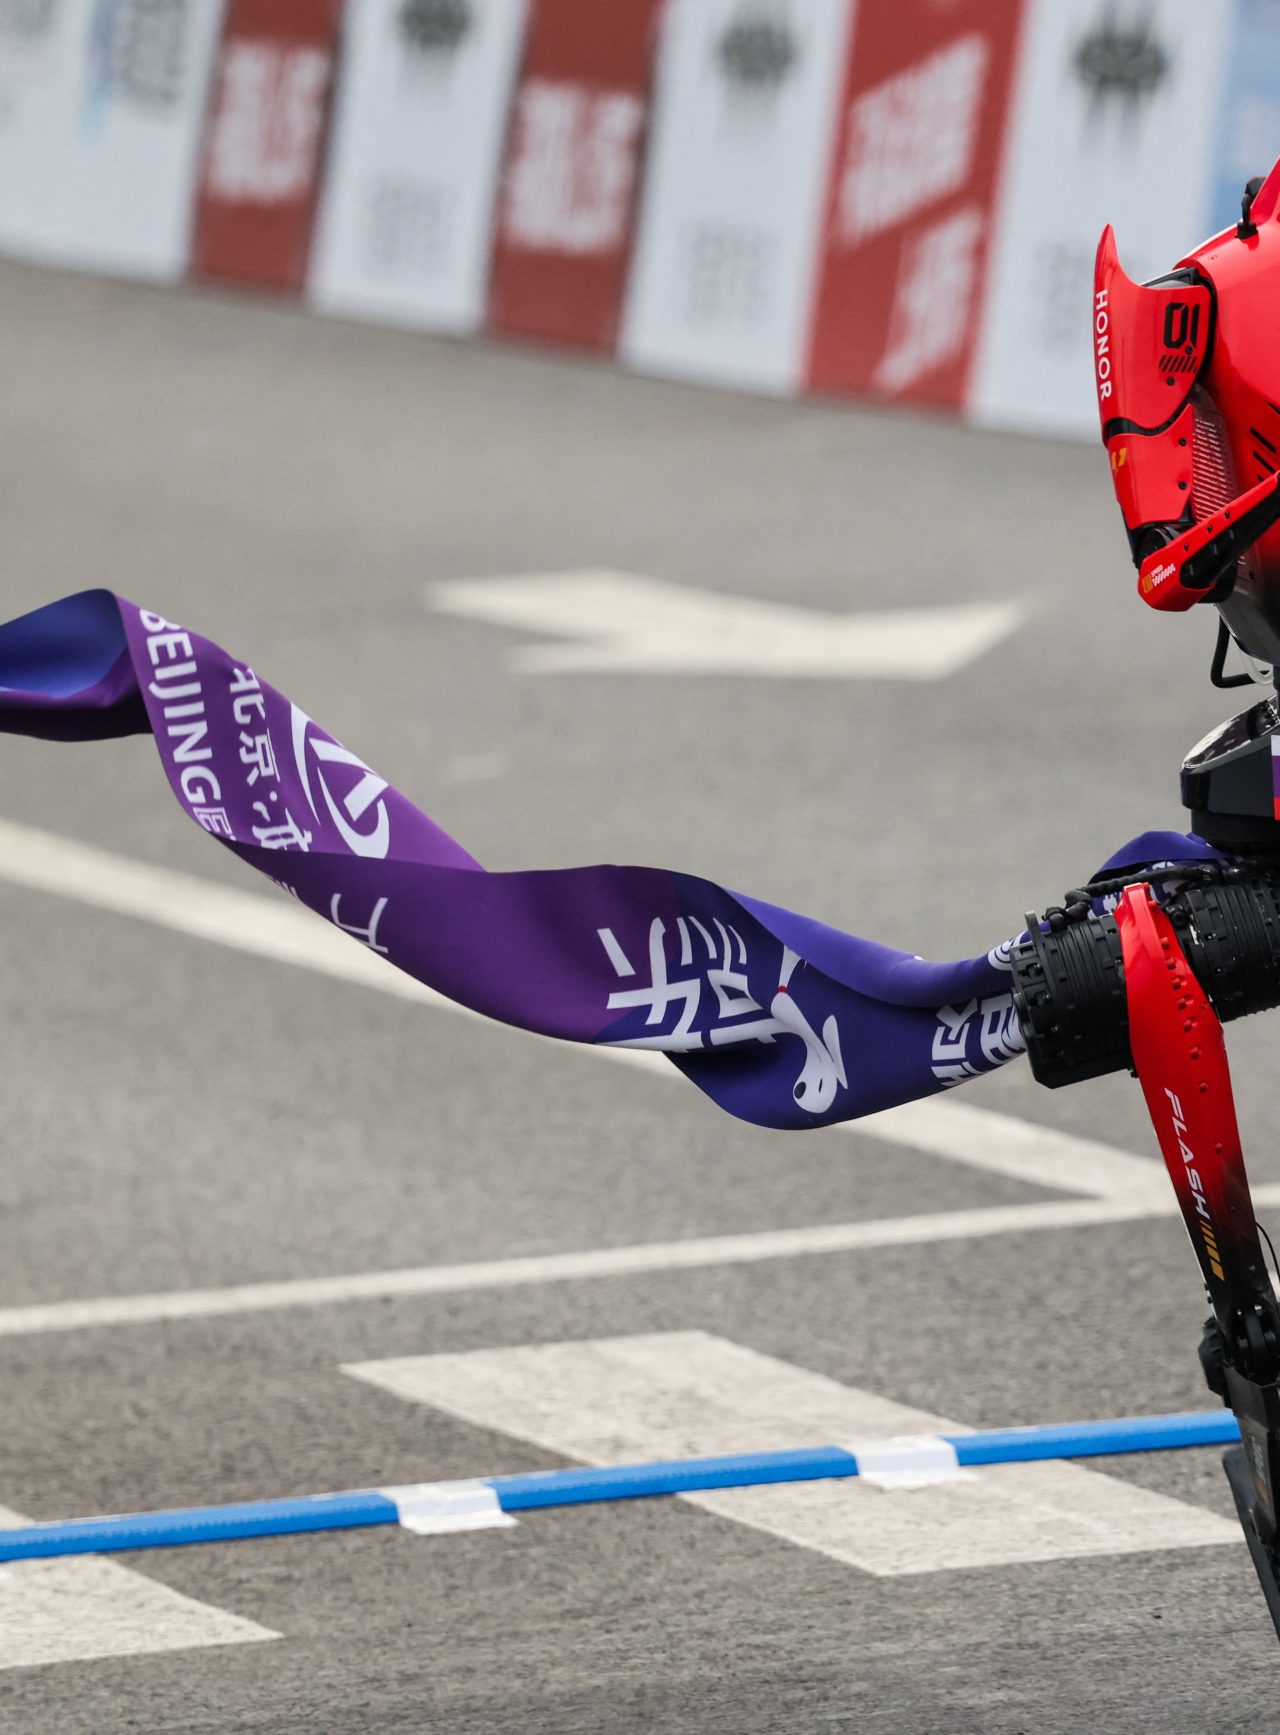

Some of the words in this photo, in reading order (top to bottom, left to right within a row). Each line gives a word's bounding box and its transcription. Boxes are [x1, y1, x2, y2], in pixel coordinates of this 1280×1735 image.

[1096, 289, 1112, 402] HONOR
[1162, 302, 1200, 349] 01
[1164, 1087, 1212, 1220] FLASH
